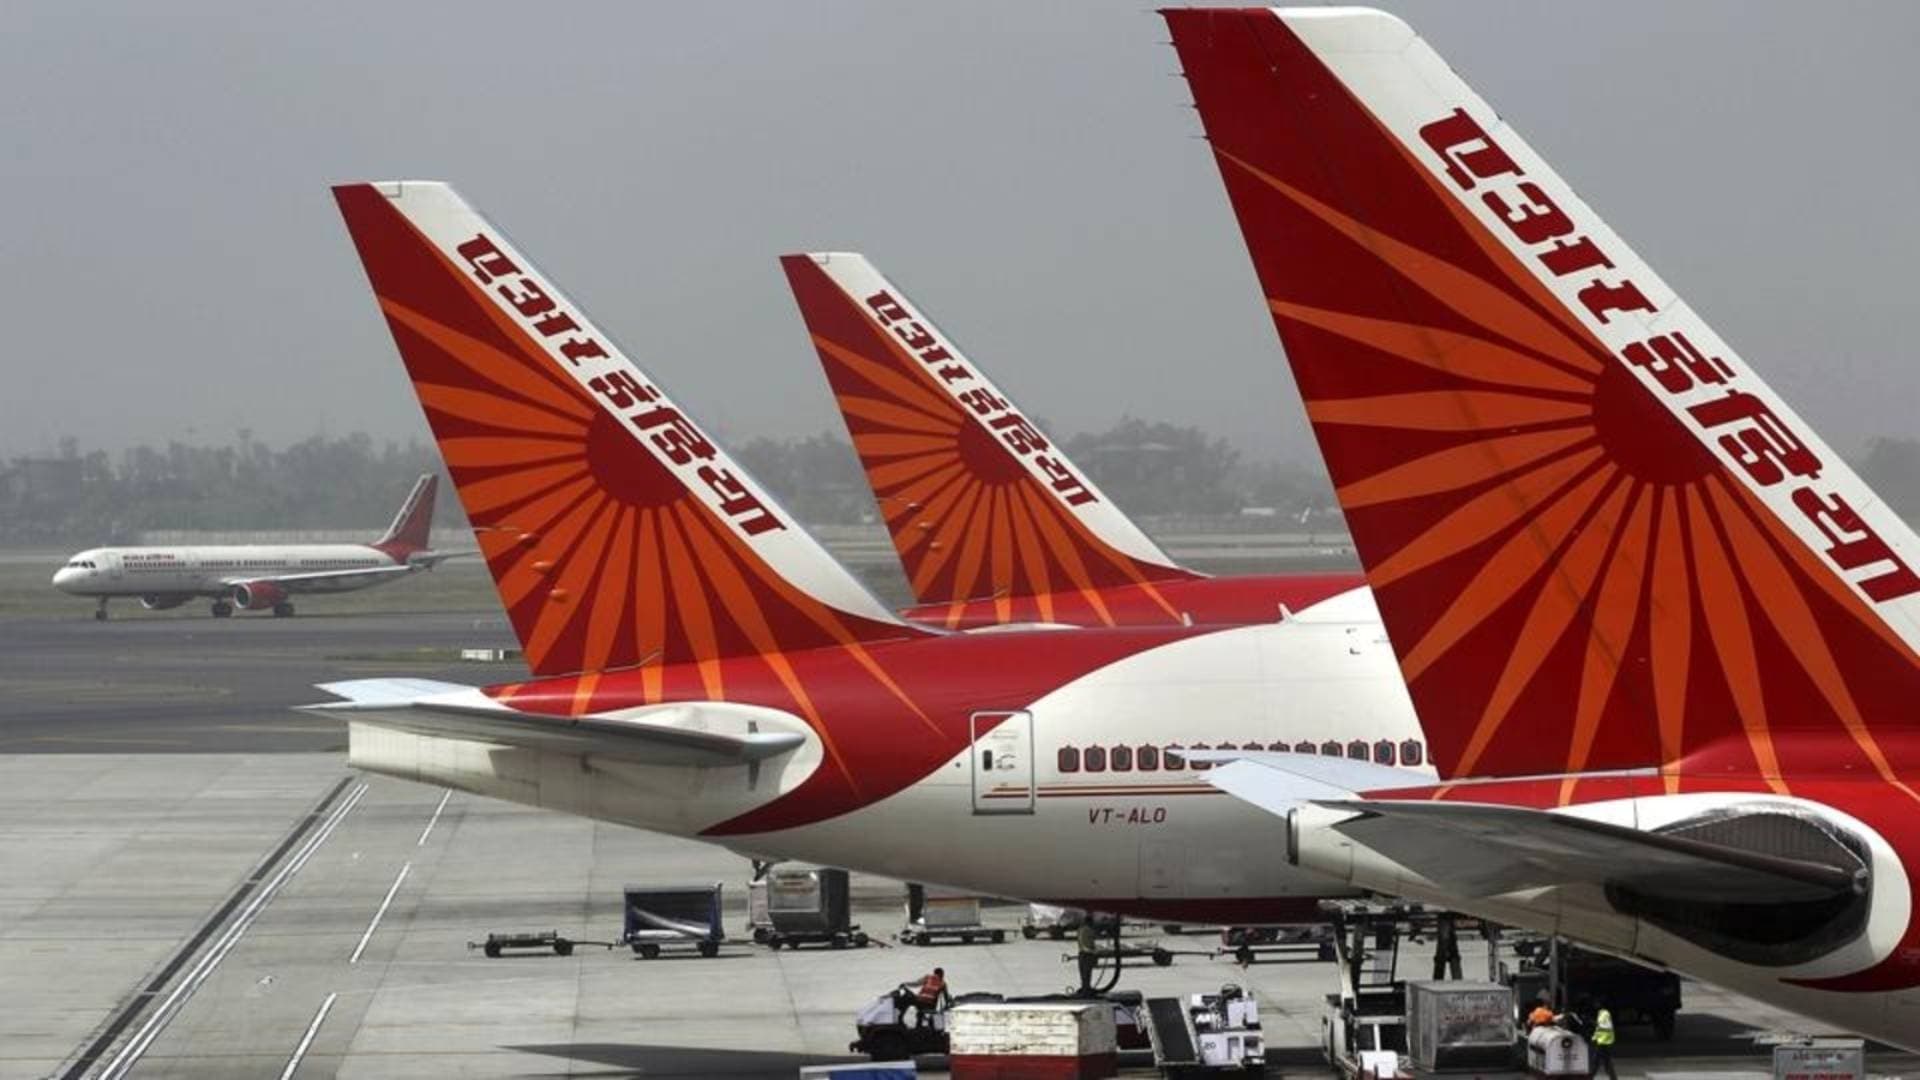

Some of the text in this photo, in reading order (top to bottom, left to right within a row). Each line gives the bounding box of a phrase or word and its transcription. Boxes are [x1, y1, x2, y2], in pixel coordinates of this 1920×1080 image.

[457, 233, 788, 536] एअर इंडिया
[865, 289, 1099, 507] एअर इंडिया
[1418, 107, 1920, 604] एअर इंडिया
[1089, 806, 1167, 825] VT-ALO
